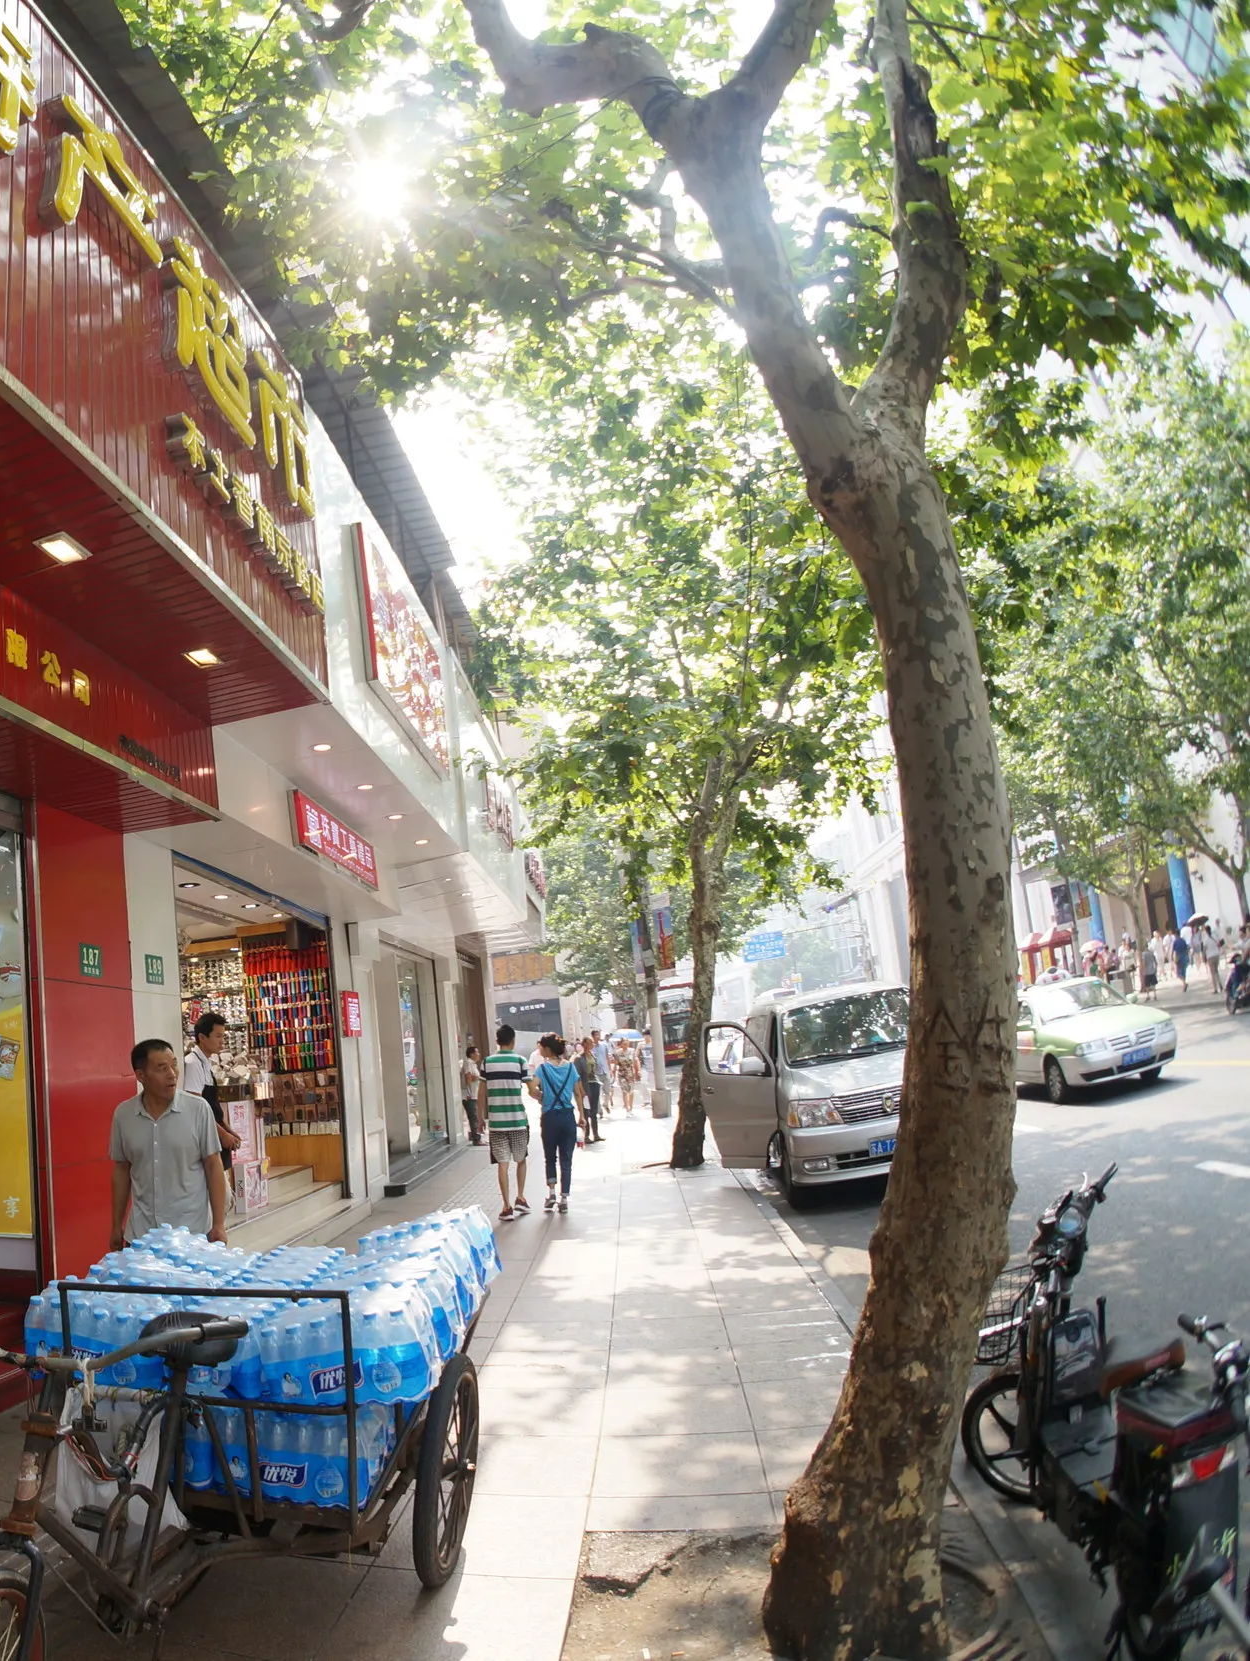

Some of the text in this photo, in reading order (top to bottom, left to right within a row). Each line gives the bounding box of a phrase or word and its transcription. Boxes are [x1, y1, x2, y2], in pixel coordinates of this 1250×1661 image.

[83, 947, 99, 966] 187
[148, 958, 162, 975] 189
[263, 1464, 298, 1484] 优悦
